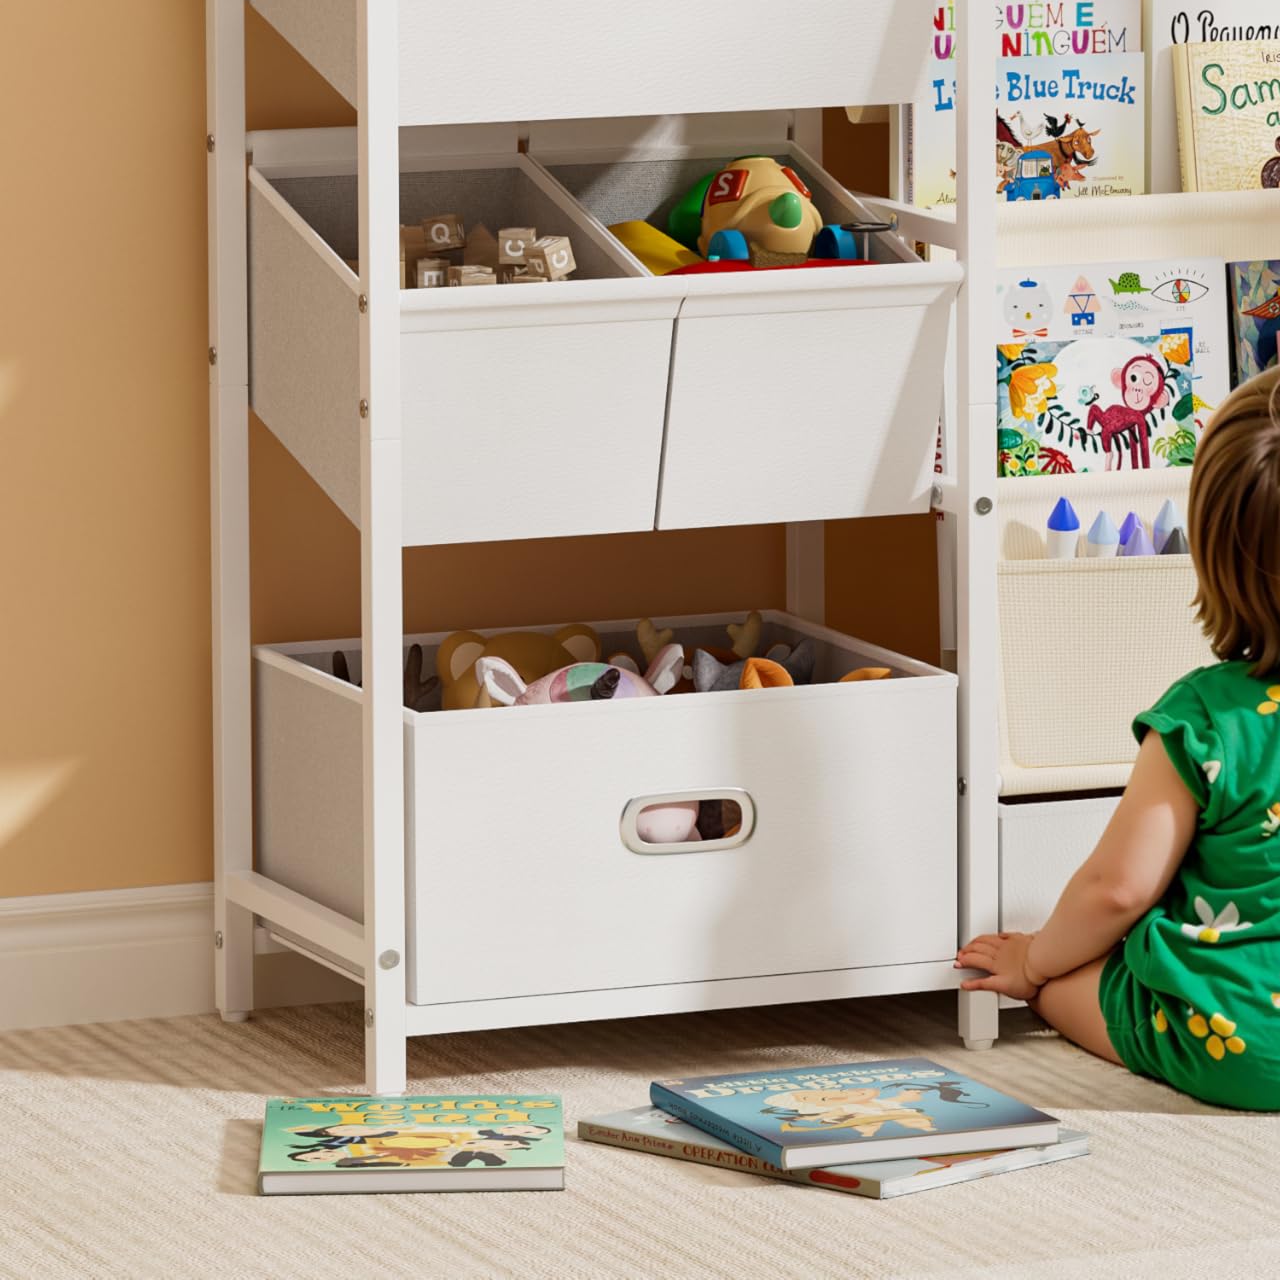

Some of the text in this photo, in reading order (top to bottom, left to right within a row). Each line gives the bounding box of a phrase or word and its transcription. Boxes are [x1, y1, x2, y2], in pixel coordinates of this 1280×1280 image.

[1006, 69, 1136, 105] Blue Truck
[431, 223, 451, 244] Q
[305, 1098, 558, 1114] World's
[336, 1109, 533, 1125] End
[682, 1145, 758, 1169] OPERATION
